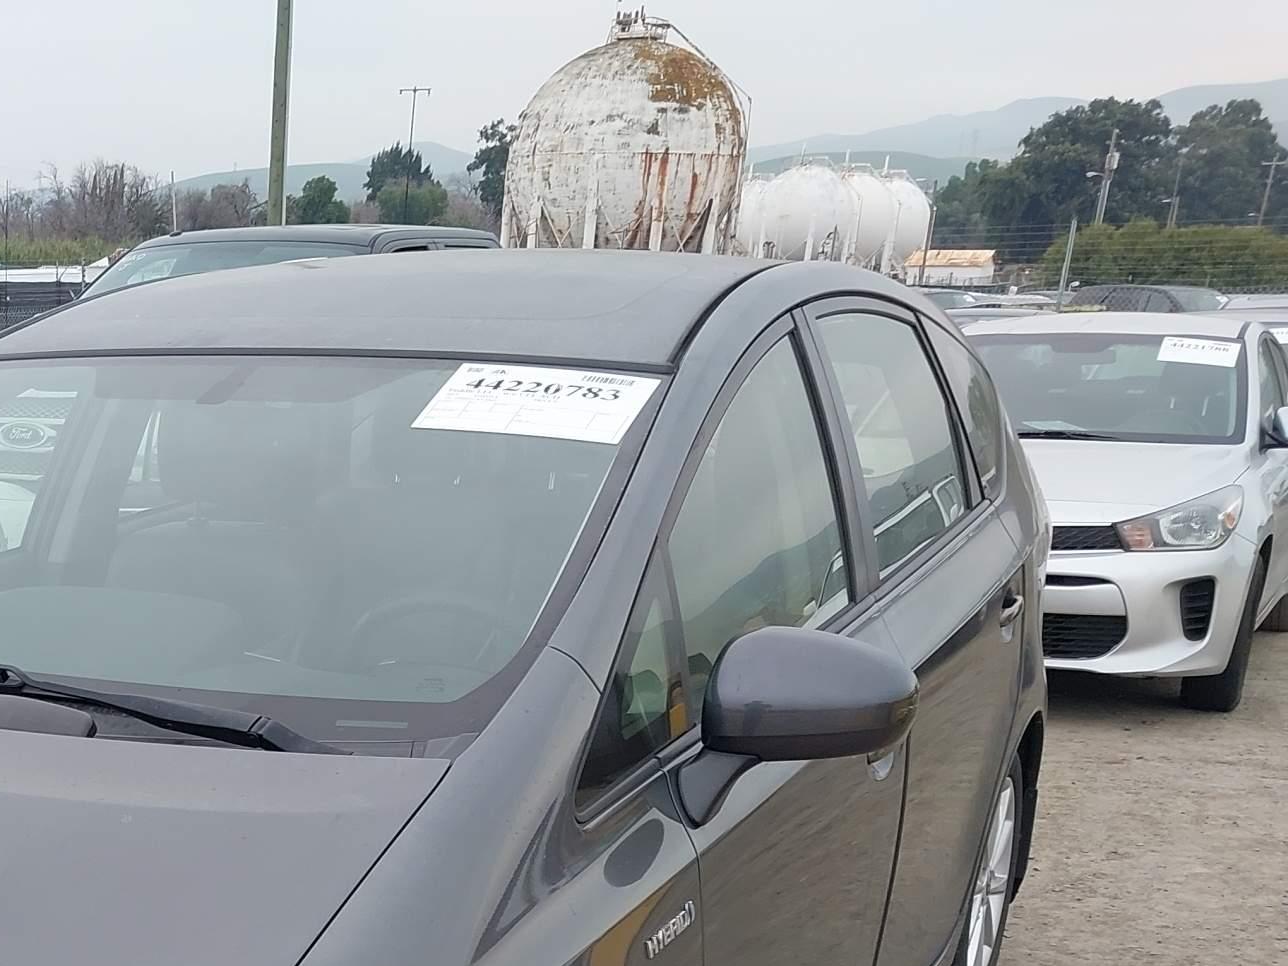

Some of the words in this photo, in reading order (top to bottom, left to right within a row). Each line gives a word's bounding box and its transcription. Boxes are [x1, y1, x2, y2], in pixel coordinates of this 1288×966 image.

[466, 377, 620, 401] 44220783
[9, 427, 33, 440] Ford
[645, 900, 696, 959] HYBRID
